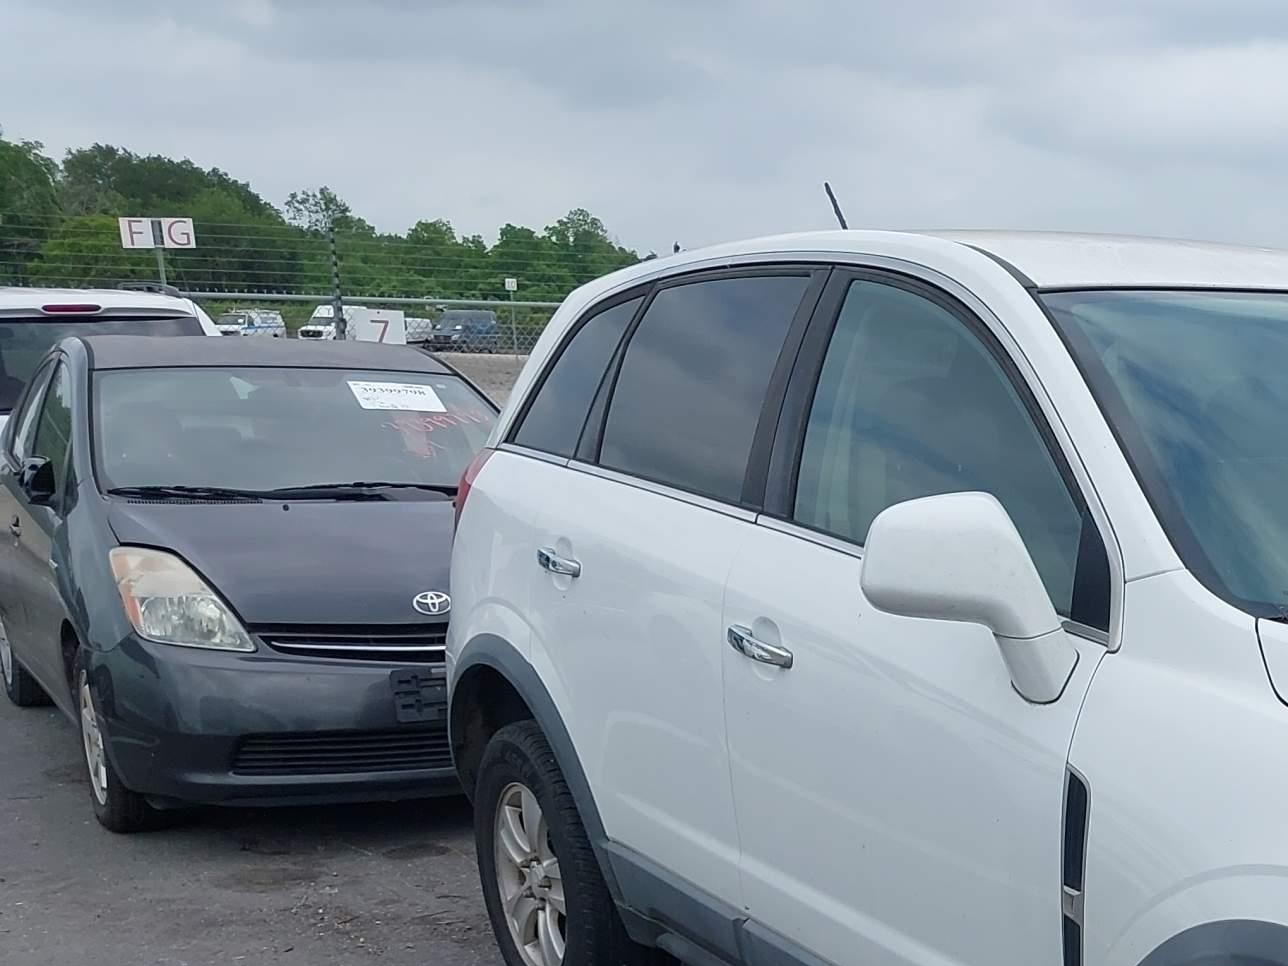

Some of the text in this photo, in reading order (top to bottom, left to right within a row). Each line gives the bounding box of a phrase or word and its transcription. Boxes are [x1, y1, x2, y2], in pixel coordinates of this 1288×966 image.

[127, 219, 191, 246] F G
[370, 319, 389, 343] 7
